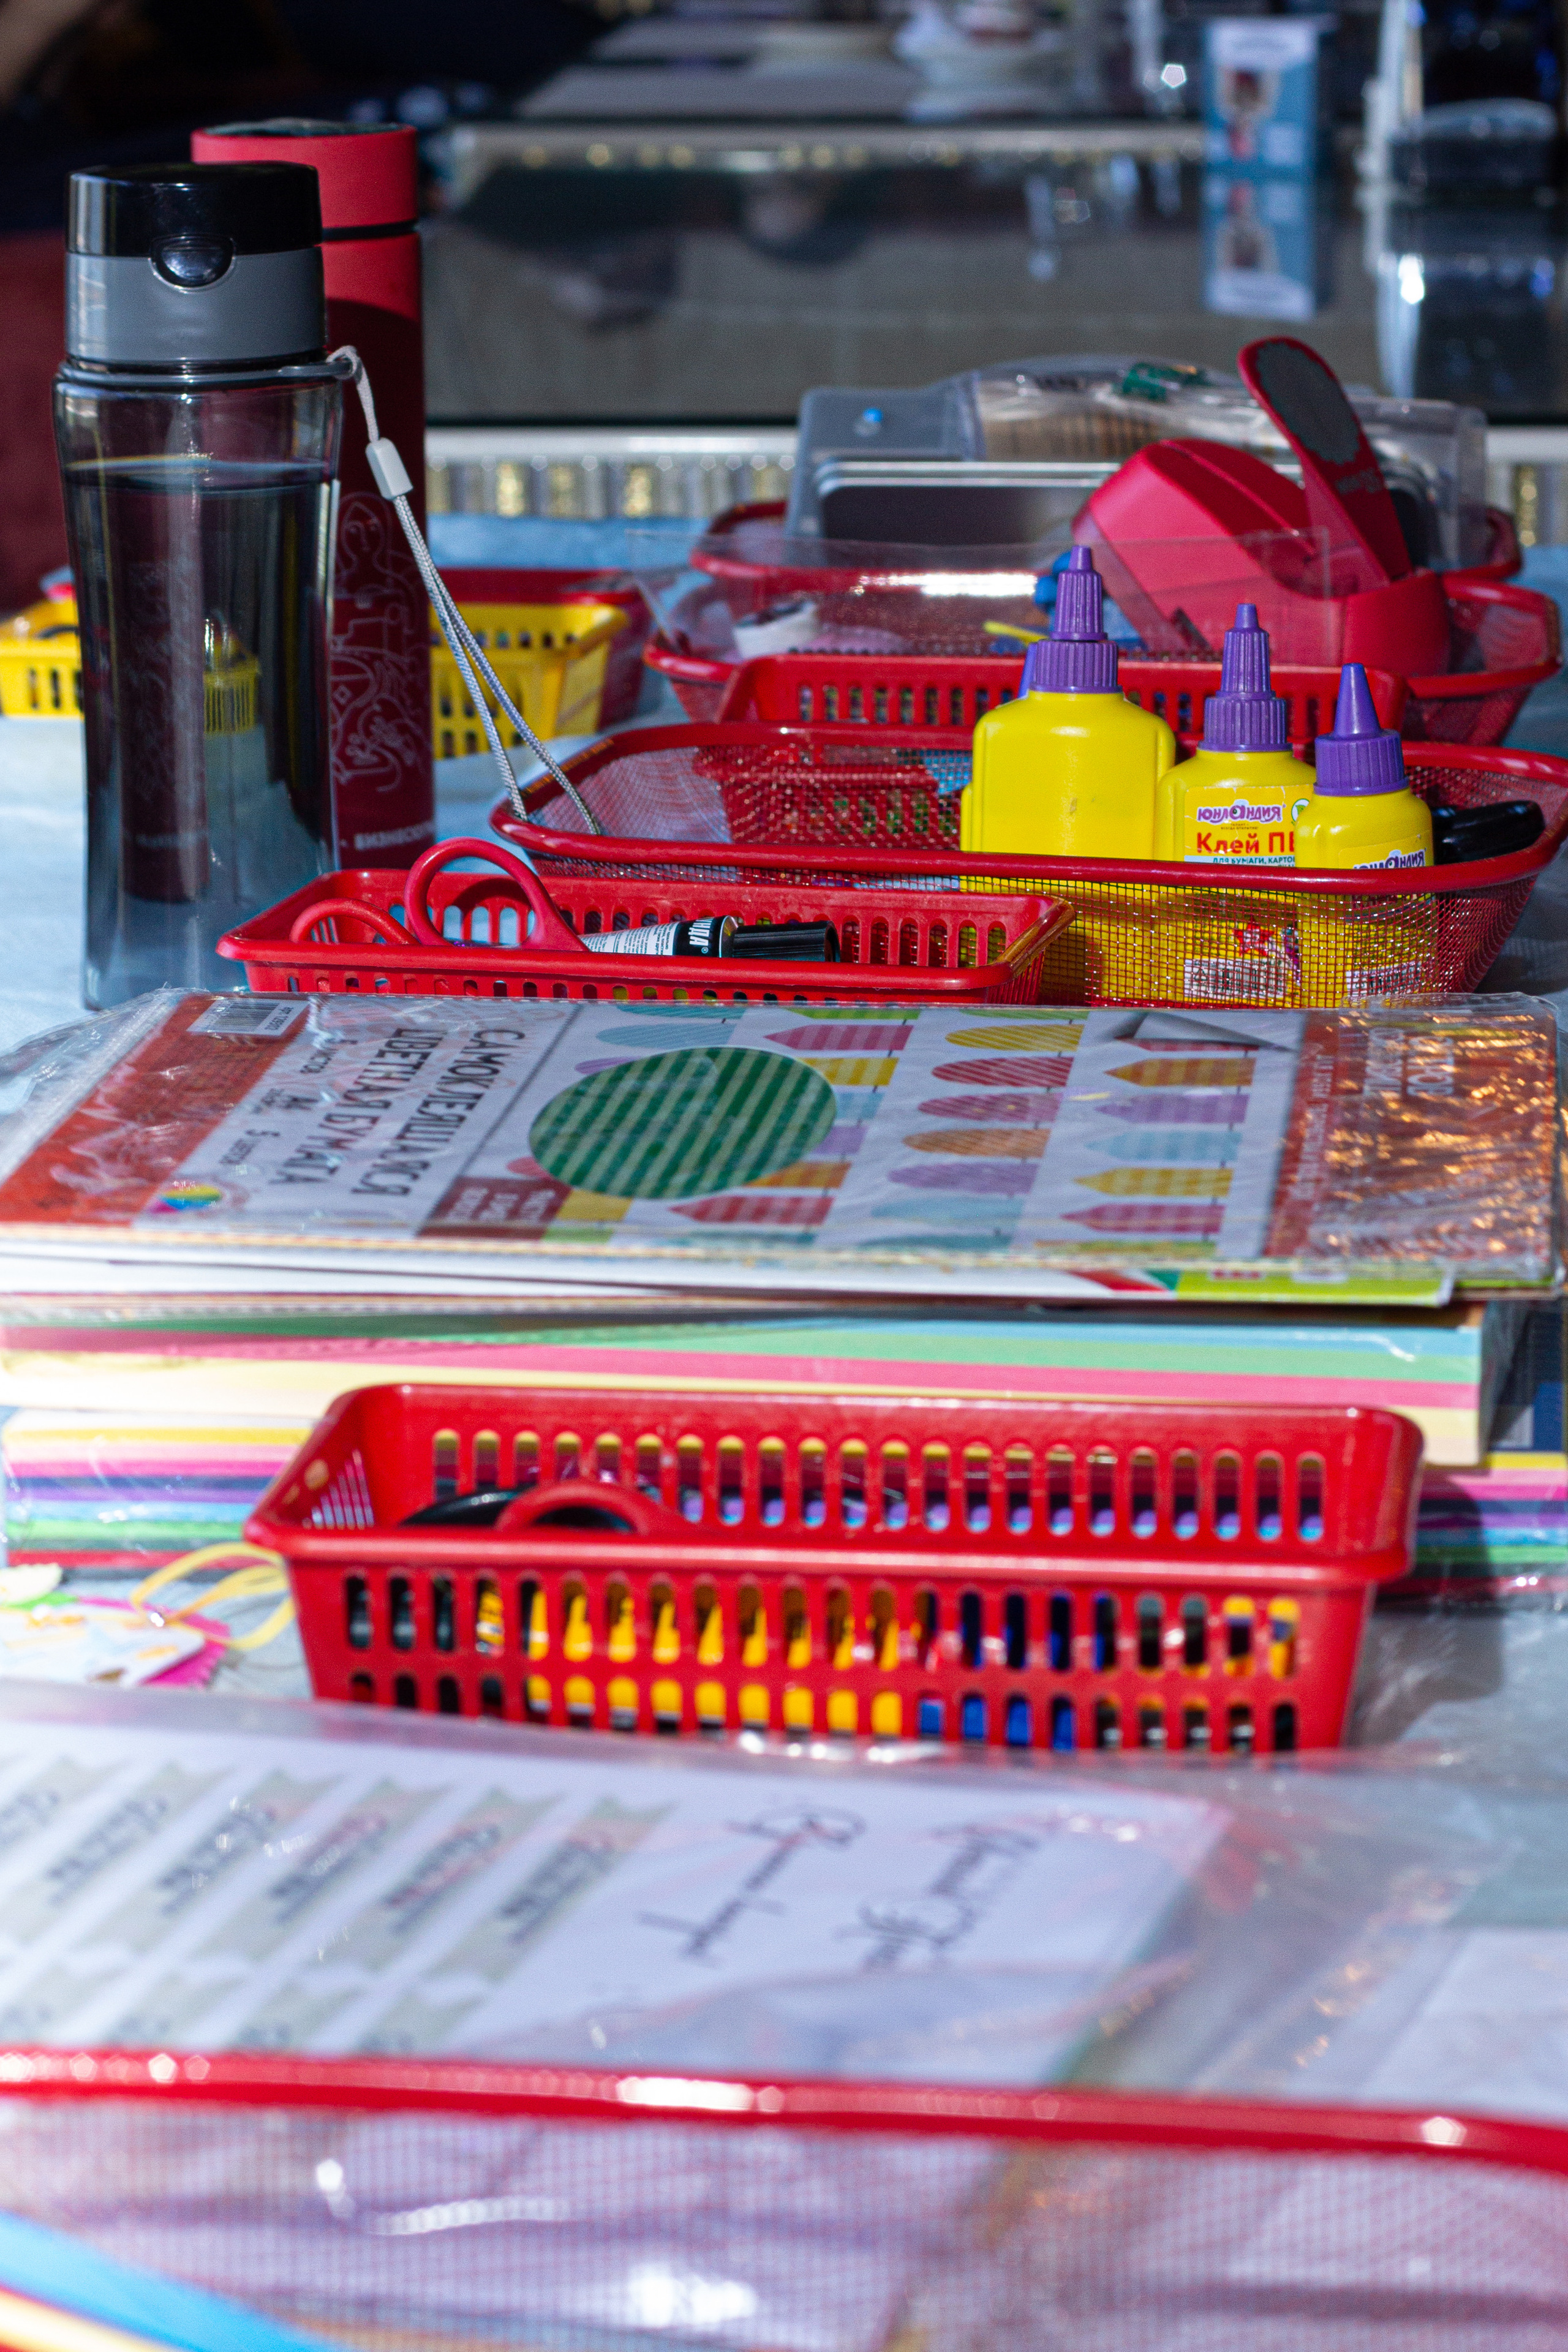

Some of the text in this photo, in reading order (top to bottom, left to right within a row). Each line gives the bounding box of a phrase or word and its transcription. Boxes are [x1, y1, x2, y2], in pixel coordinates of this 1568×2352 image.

[1197, 832, 1259, 854] Клей
[268, 1028, 447, 1185] ЦВЕТНАЯ БУМАГА
[351, 1028, 525, 1196] САМОКЛЕЯЩАЯСЯ
